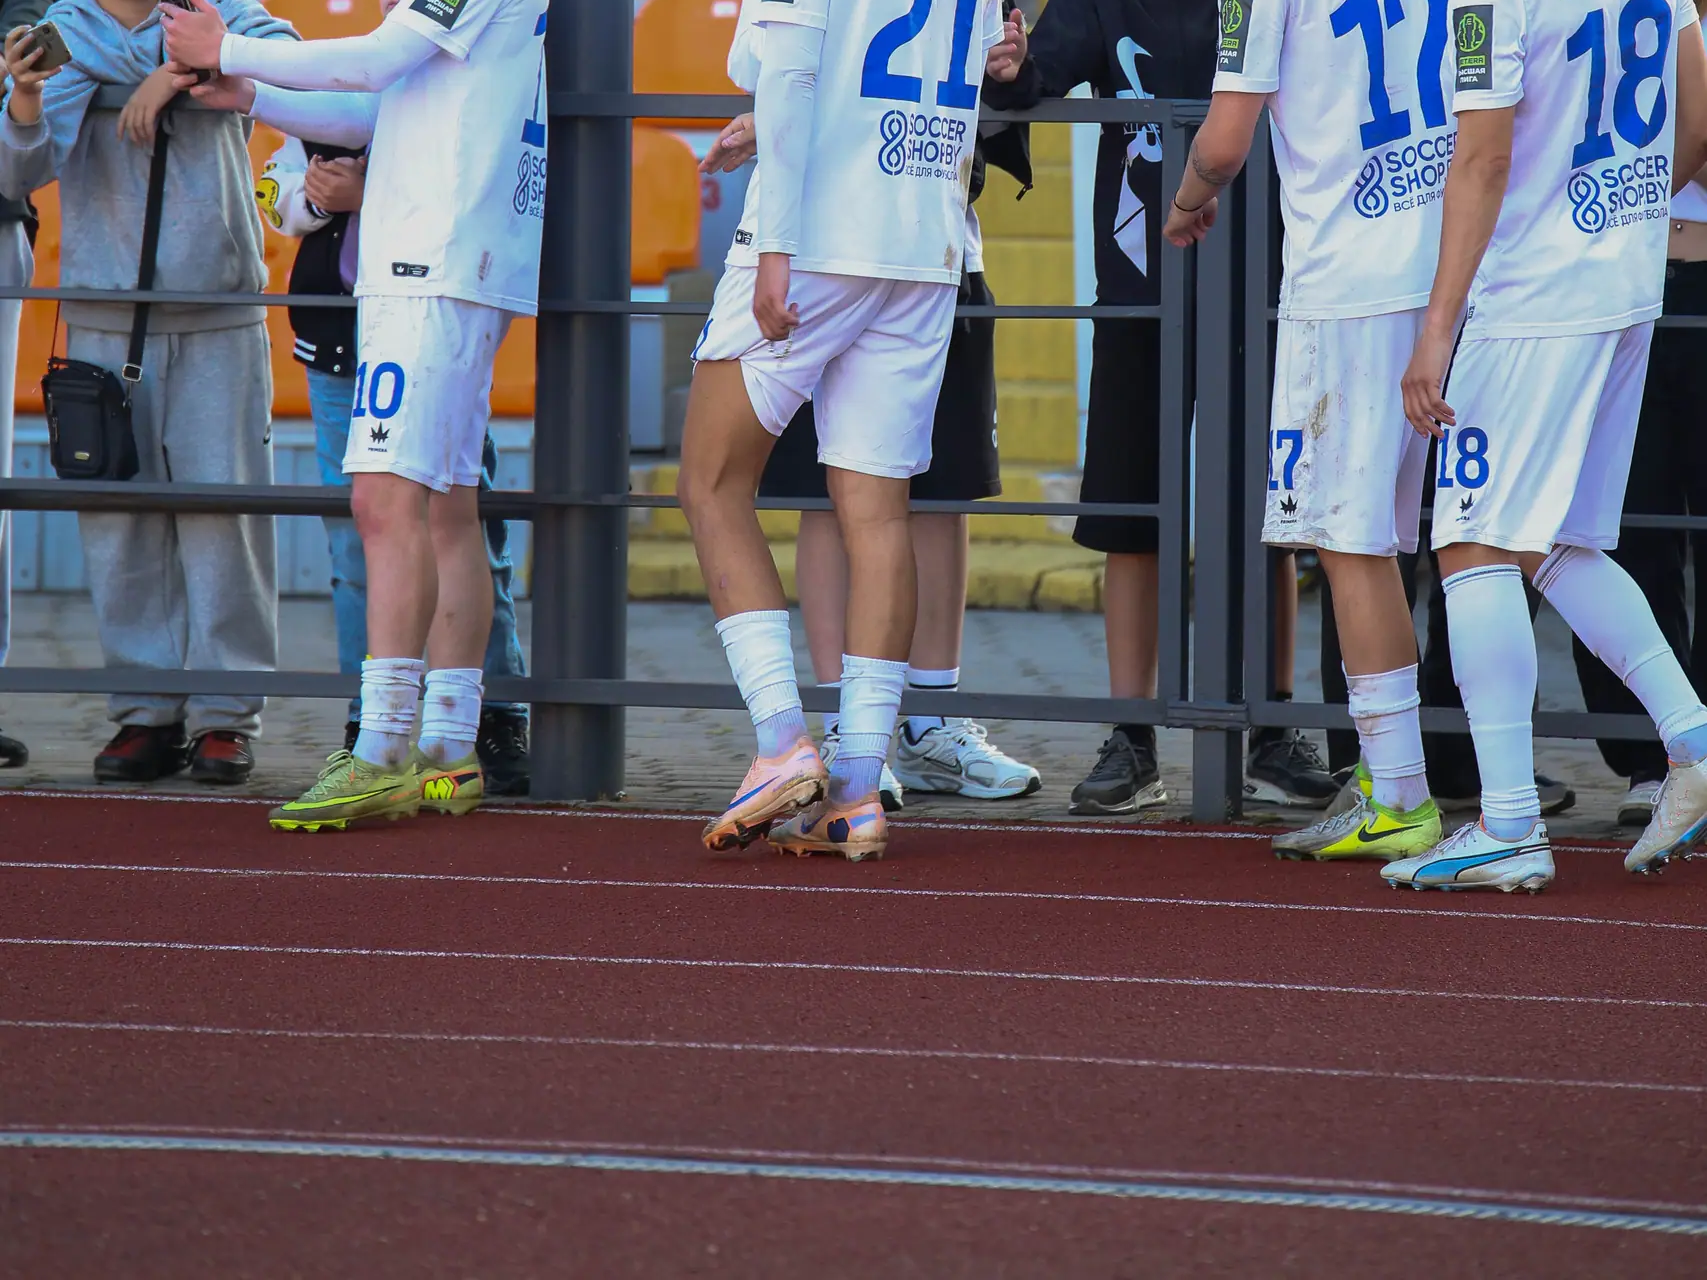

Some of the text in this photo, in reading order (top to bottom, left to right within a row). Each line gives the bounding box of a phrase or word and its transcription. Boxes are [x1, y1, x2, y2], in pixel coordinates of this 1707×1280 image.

[1458, 67, 1486, 76] ЫСШАЯ
[909, 113, 966, 142] SOCCER
[915, 166, 932, 178] ДЛЯ
[1393, 196, 1416, 212] ВСЁ
[1417, 191, 1435, 207] ДЛЯ
[1637, 207, 1668, 221] ФБОЛА
[352, 361, 405, 419] 10
[1437, 426, 1490, 489] 18
